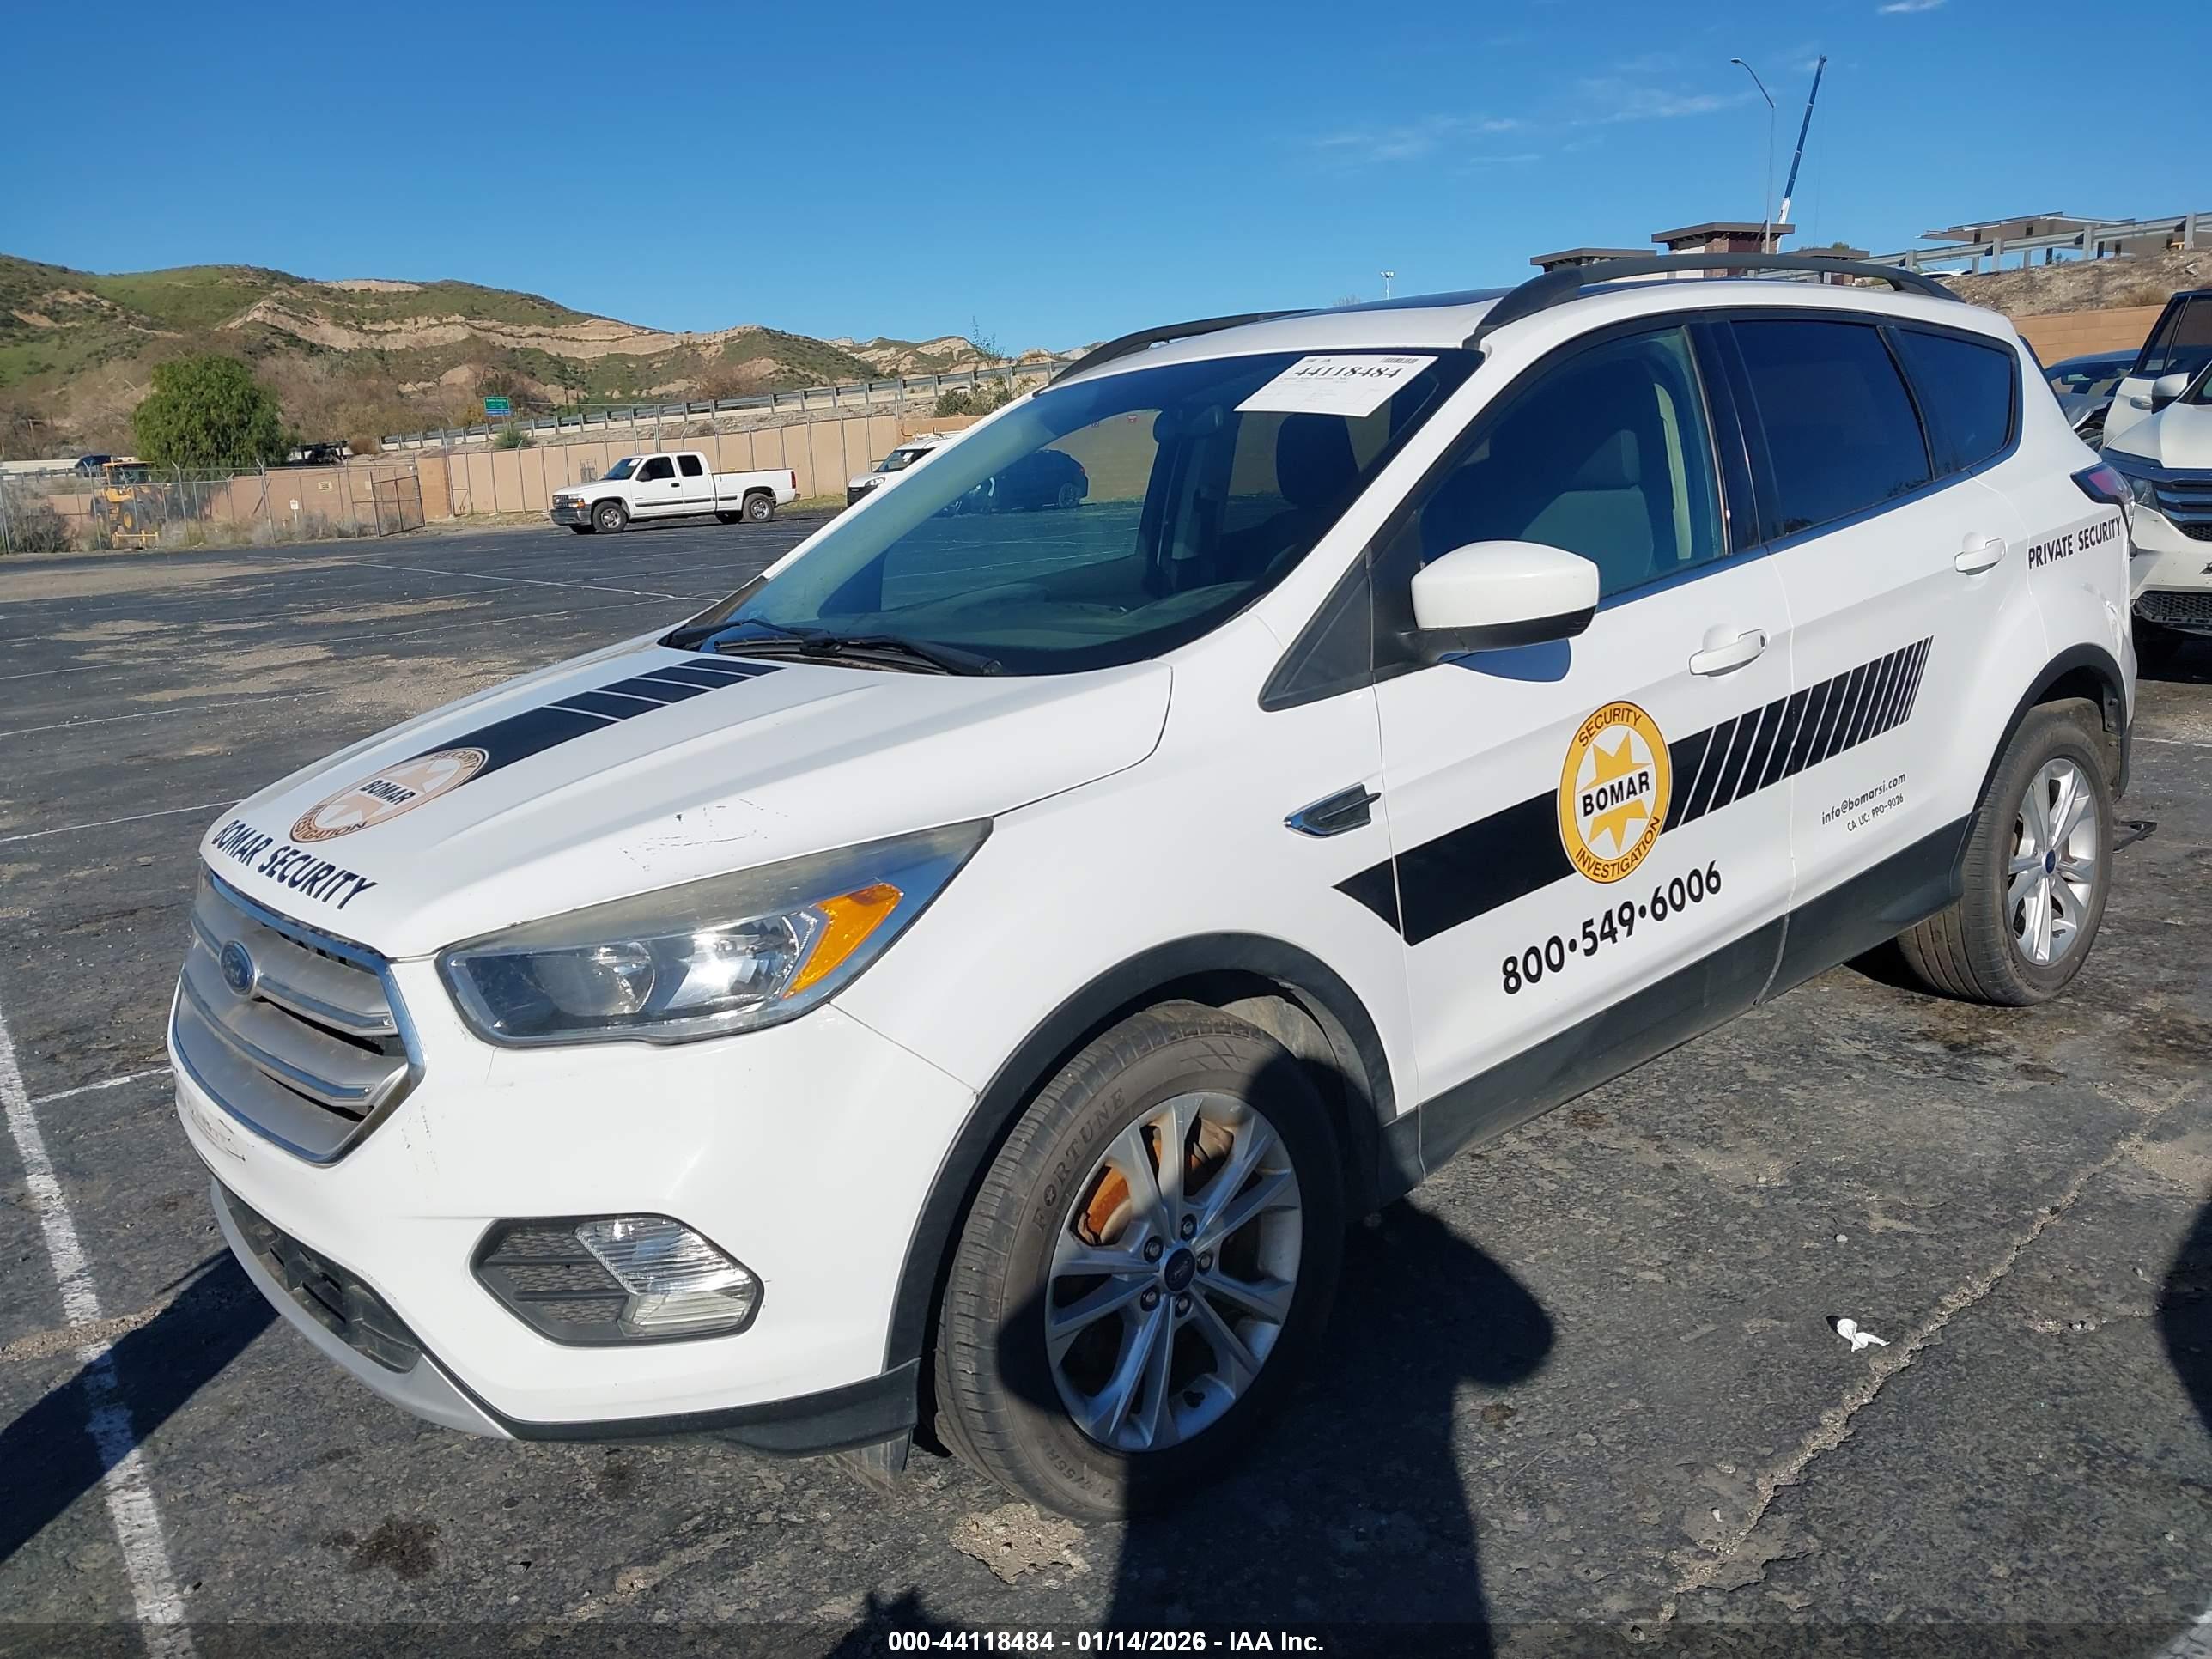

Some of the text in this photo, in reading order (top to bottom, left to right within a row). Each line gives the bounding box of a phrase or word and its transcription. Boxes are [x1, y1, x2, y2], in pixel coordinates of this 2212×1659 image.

[1294, 364, 1403, 379] 44118484
[2027, 515, 2121, 570] PRIVATE SECURITY
[1578, 707, 1642, 747] SECURITY
[358, 779, 416, 806] BOMAR
[1581, 770, 1650, 817] BOMAR
[1821, 773, 1906, 825] info@bomarsi.com
[1847, 820, 1857, 832] CA
[1871, 793, 1904, 817] PPO-9026
[211, 819, 379, 910] BOMAR SECURITY
[1575, 816, 1661, 878] INVESTIGATION
[1032, 1087, 1126, 1231] FORTUNE
